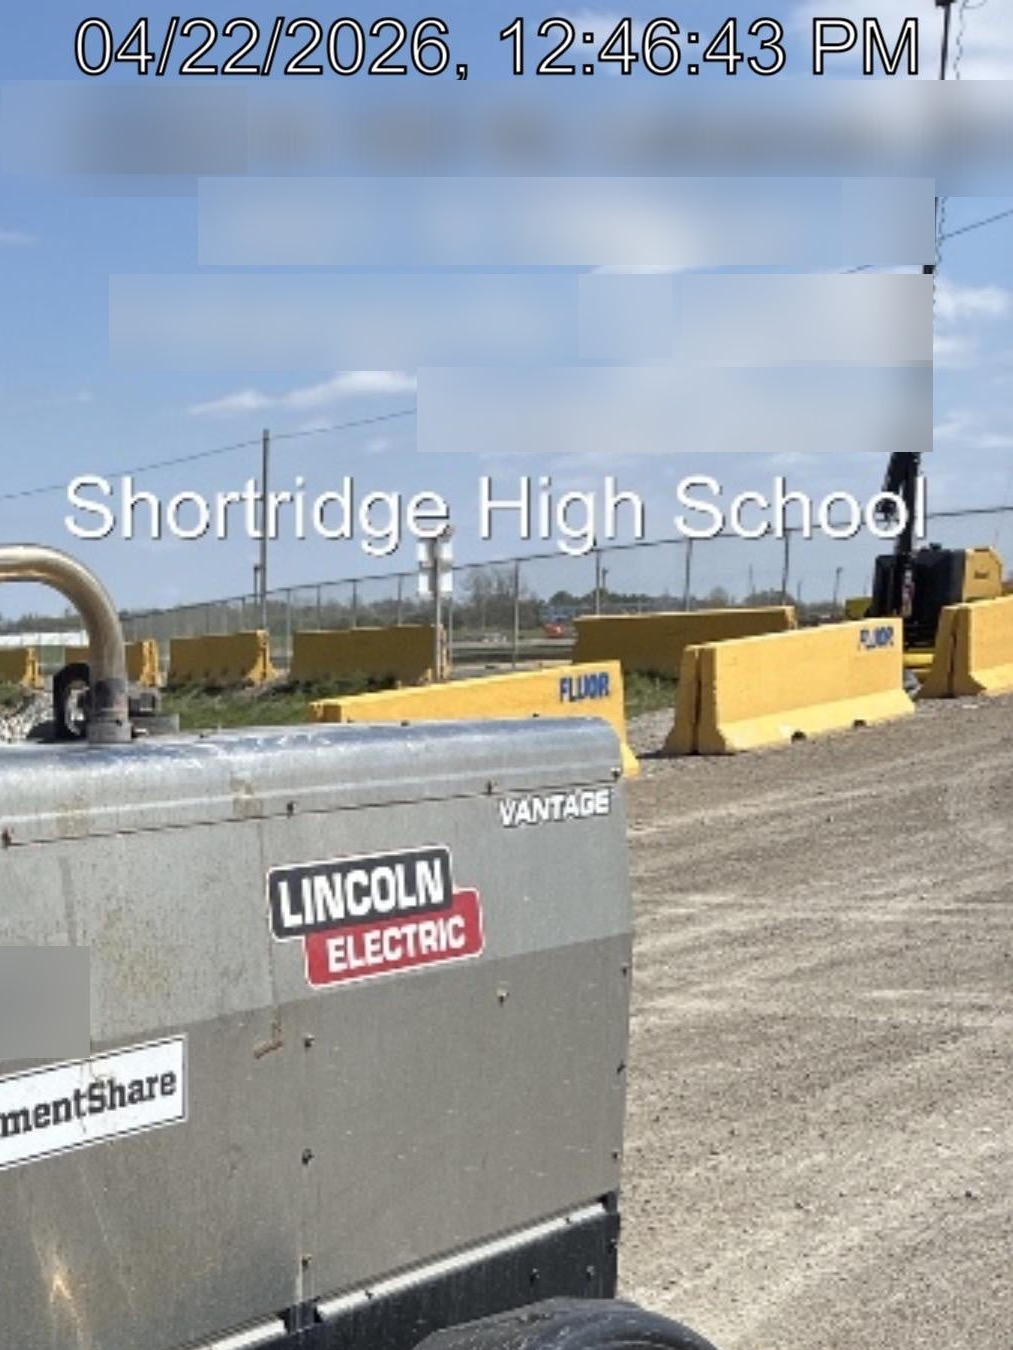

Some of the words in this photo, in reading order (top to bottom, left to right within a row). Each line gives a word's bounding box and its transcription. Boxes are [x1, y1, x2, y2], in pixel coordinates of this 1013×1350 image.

[559, 671, 610, 703] FLUOR
[499, 788, 610, 827] VANTAGE
[278, 857, 445, 928] LINCOLN
[325, 915, 466, 973] ELECTRIC
